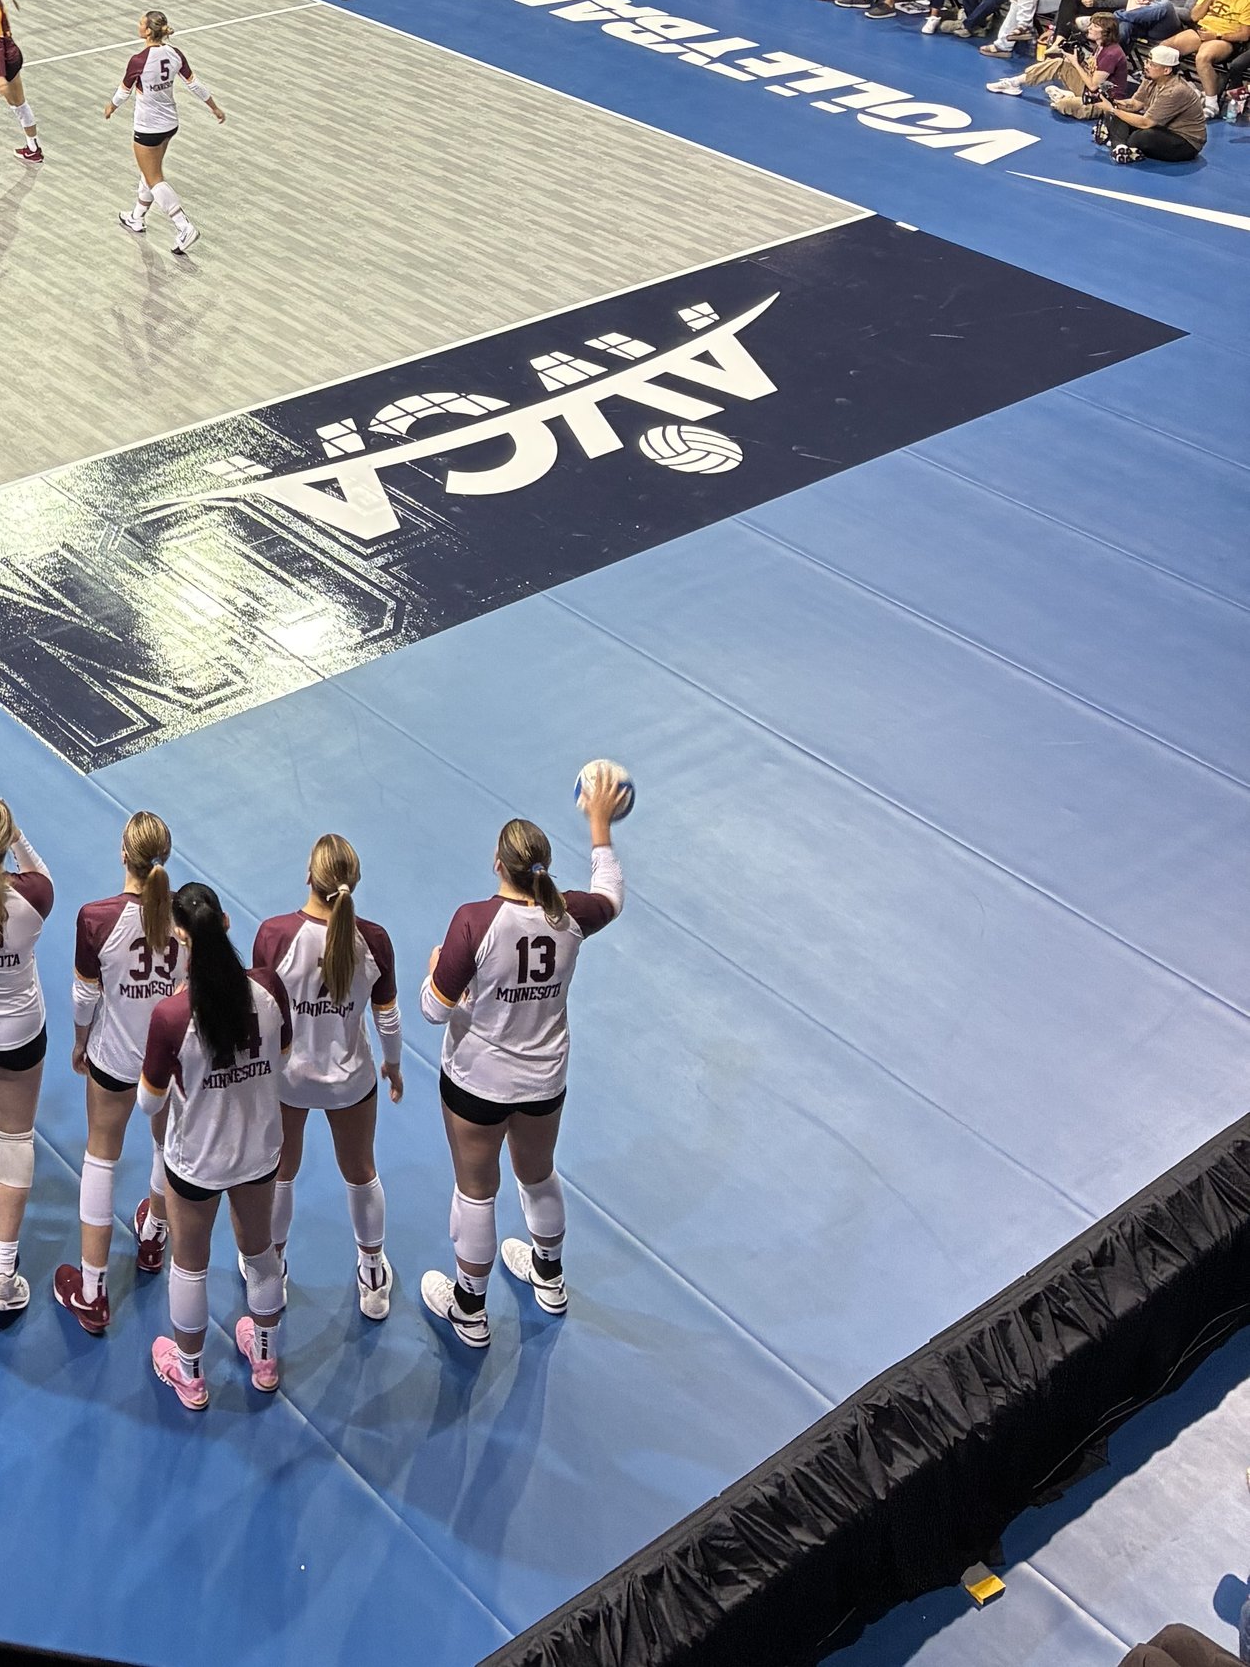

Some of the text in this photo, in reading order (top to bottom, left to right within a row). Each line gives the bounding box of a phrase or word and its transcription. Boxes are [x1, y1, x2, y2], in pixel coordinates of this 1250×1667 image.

[159, 58, 170, 80] 5
[190, 300, 780, 540] AVCA
[128, 936, 180, 981] 33
[515, 935, 557, 984] 13
[119, 981, 176, 1001] MINNESO
[495, 981, 562, 1004] MINNESOTA
[292, 998, 355, 1018] MINNESO
[202, 1059, 272, 1090] MINNESOTA
